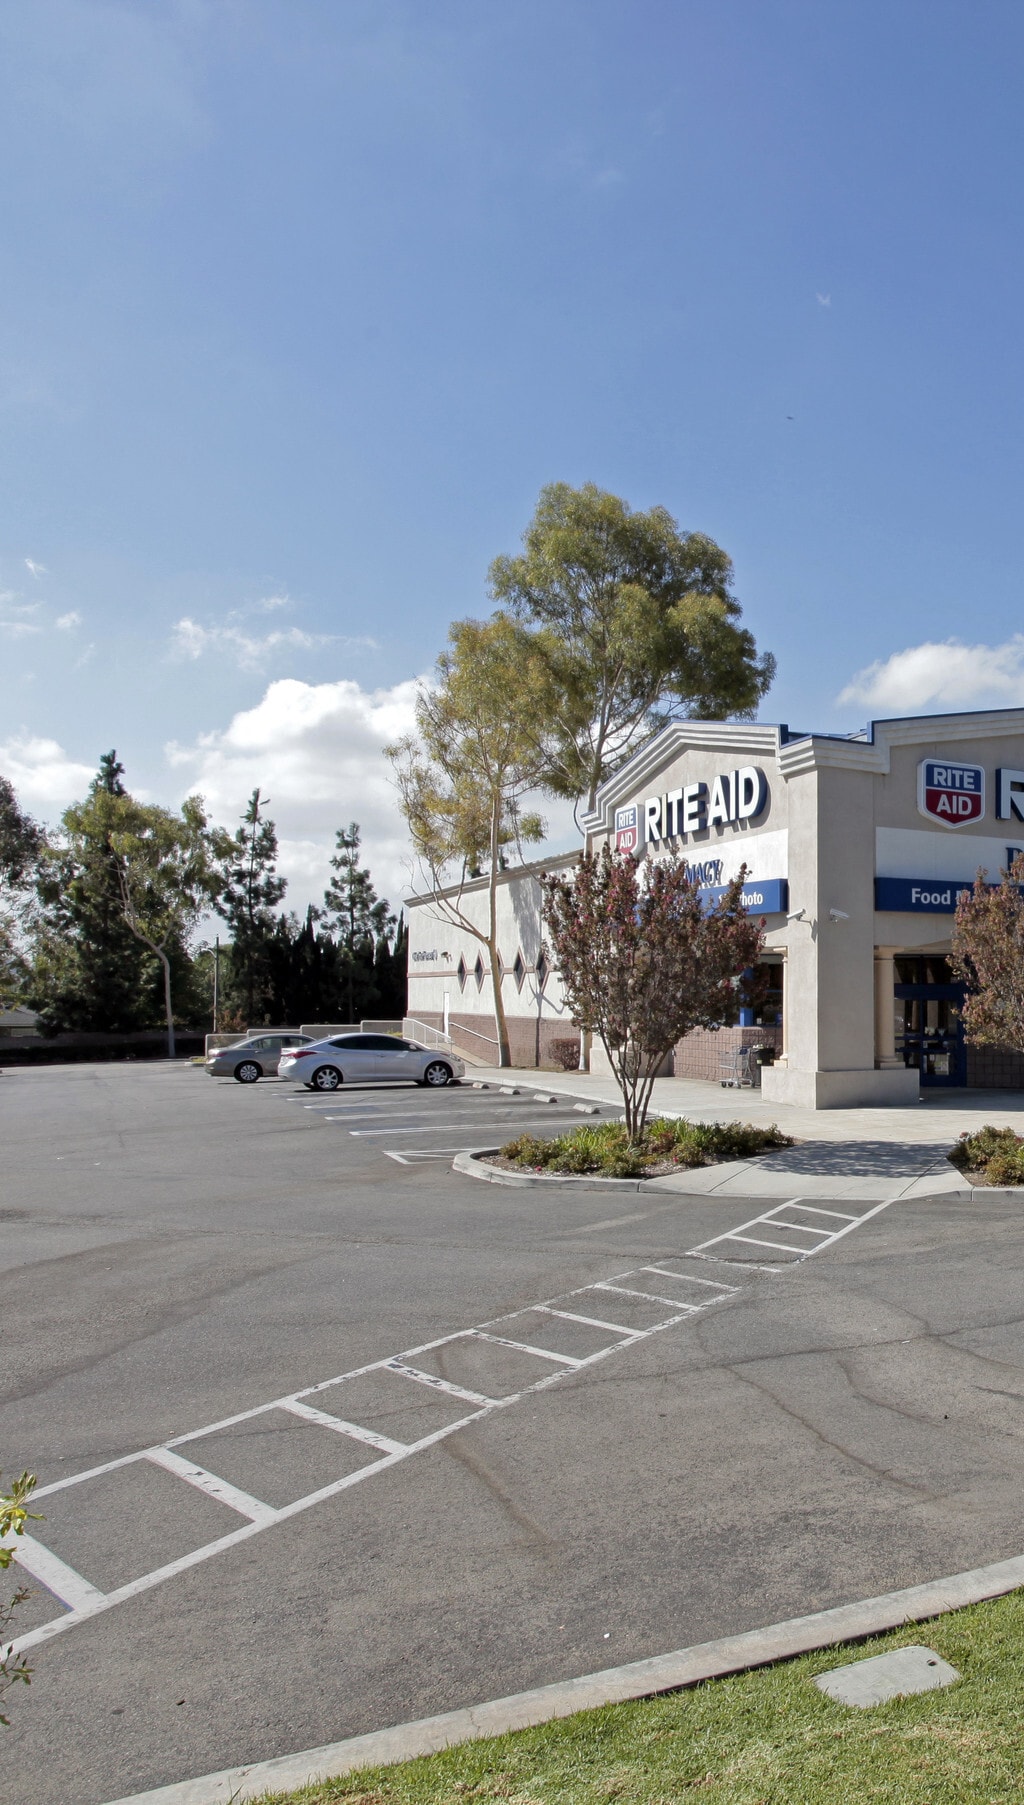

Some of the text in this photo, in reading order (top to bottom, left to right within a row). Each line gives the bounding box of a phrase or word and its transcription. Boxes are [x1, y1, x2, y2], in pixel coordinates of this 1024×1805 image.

[932, 766, 975, 790] RITE
[644, 765, 765, 843] RITE AID
[936, 794, 972, 816] AID
[618, 809, 634, 827] RITE
[619, 831, 633, 848] AID
[737, 891, 764, 906] hoto
[911, 887, 951, 905] Food
